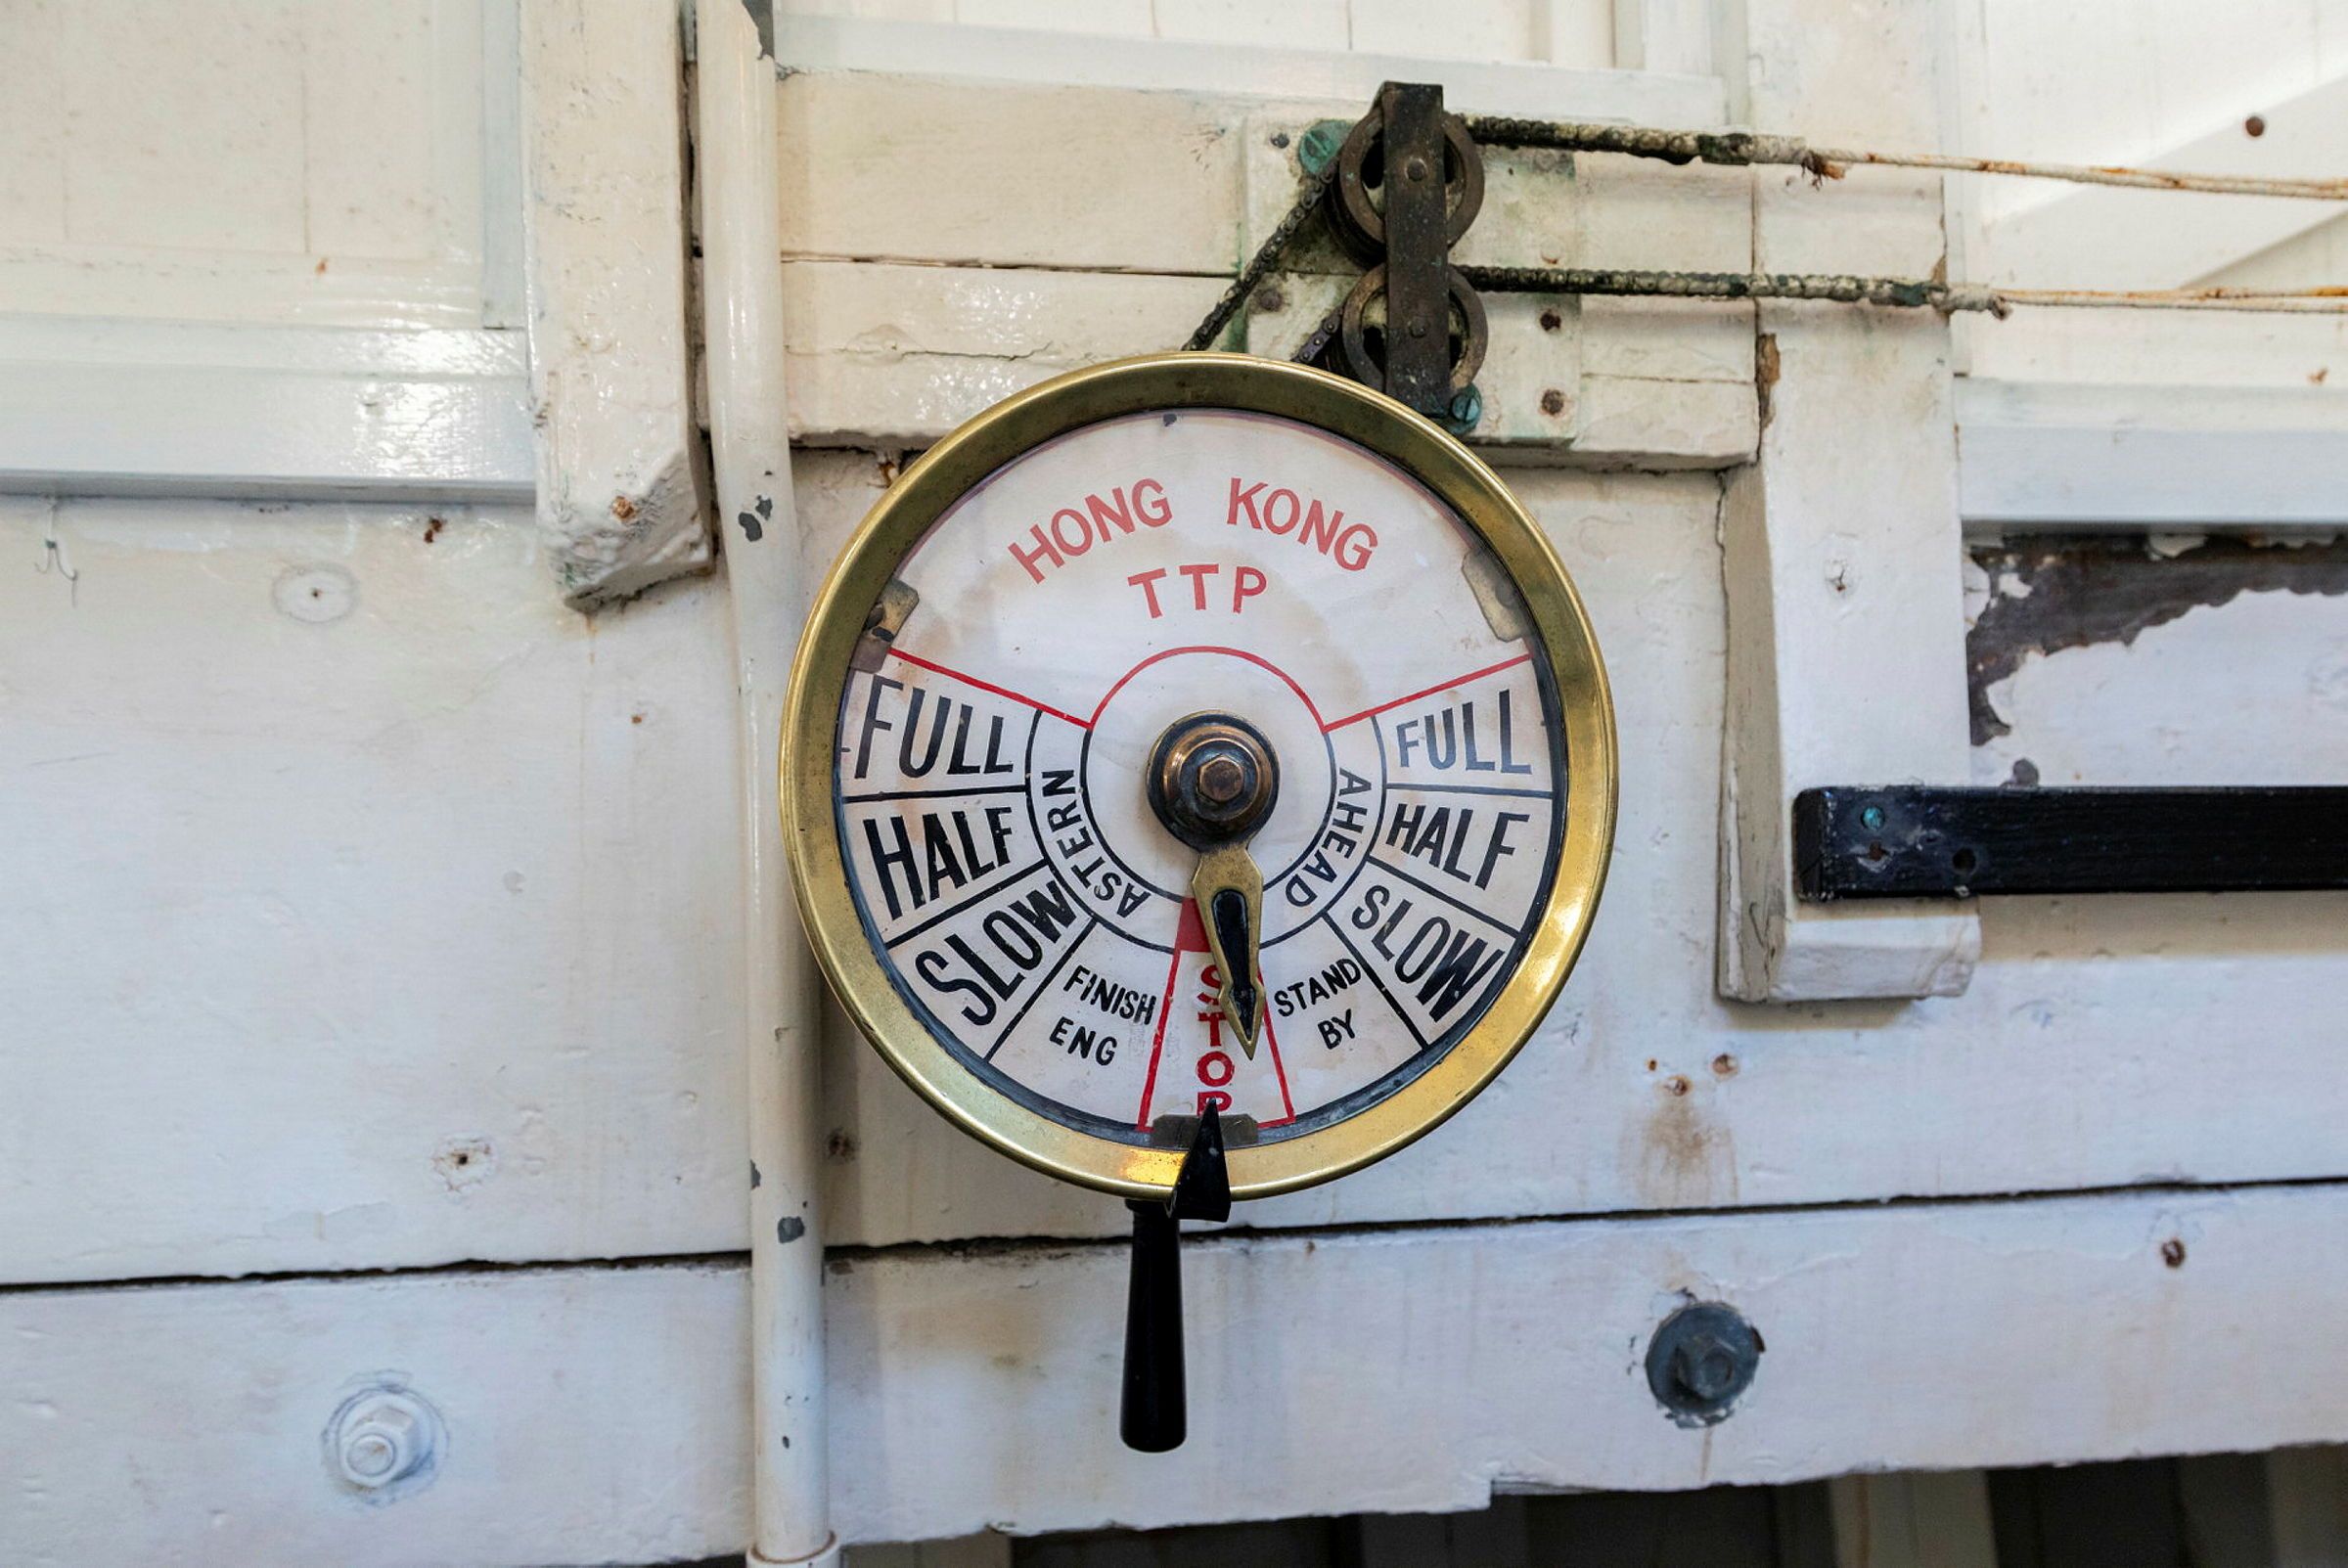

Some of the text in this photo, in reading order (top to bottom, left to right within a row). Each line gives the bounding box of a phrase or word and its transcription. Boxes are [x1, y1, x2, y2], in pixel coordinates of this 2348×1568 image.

[1008, 477, 1378, 584] HONG KONG
[1127, 563, 1267, 619] TTP
[854, 675, 1014, 779] FULL
[1396, 690, 1532, 775] FULL
[863, 806, 1013, 920] HALF
[1041, 770, 1151, 918] ASTERN
[1285, 767, 1372, 908] AHEAD
[1385, 803, 1531, 891] HALF
[915, 880, 1077, 1026] SLOW
[1062, 964, 1157, 1025] FINISH
[1274, 958, 1363, 1017] STAND
[1351, 884, 1506, 1023] SLOW
[1049, 1016, 1119, 1066] ENG
[1317, 1009, 1357, 1050] BY
